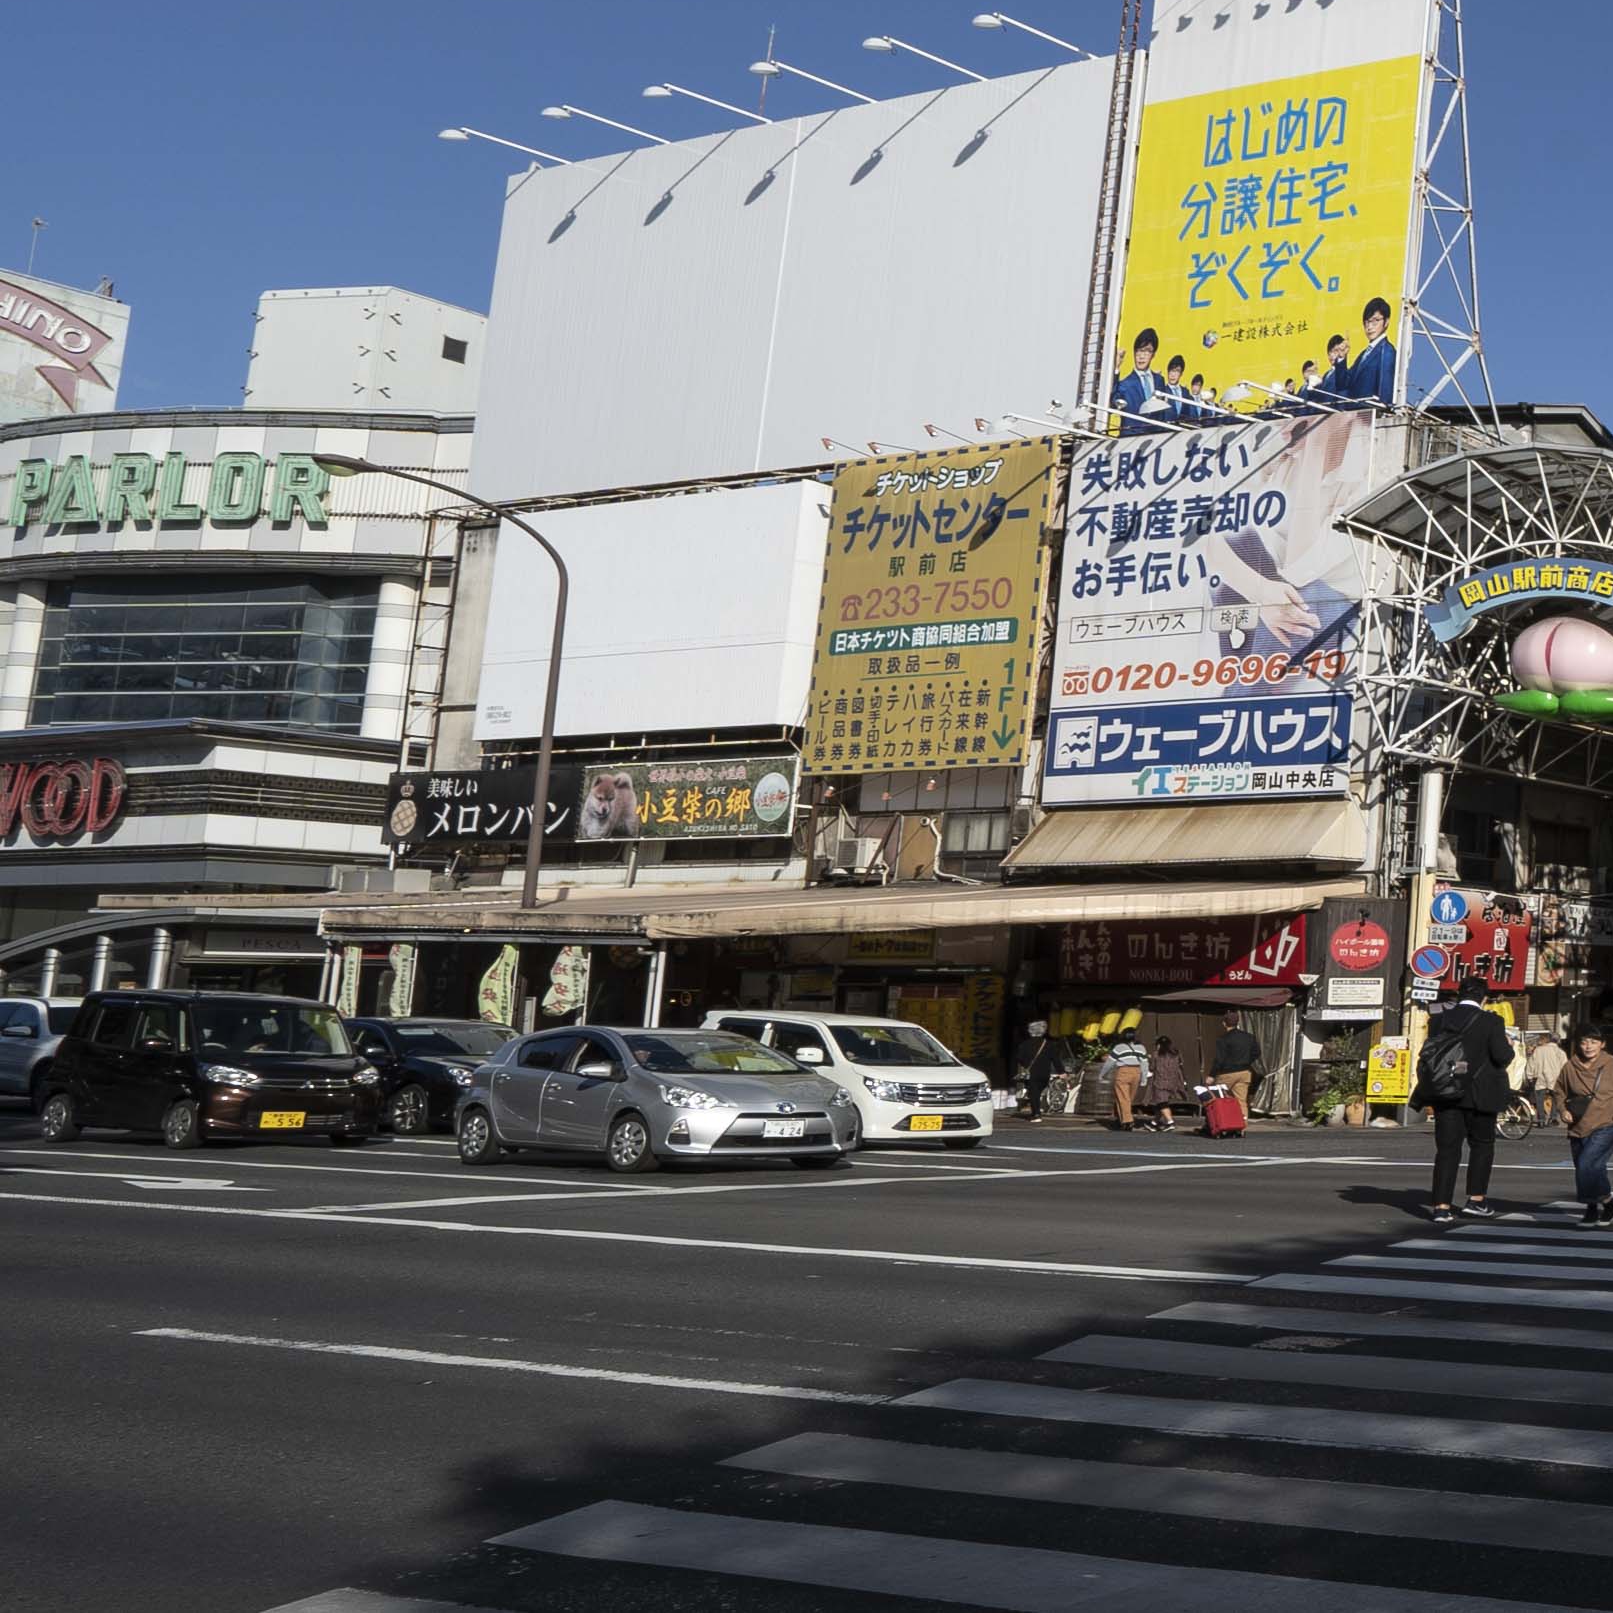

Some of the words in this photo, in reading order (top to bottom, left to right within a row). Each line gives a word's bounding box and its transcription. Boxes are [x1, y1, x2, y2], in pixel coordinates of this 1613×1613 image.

[1203, 97, 1347, 167] はじめの
[1178, 161, 1358, 241] 分譲住宅、
[1187, 234, 1339, 308] ぞくぞく。
[1221, 321, 1309, 342] 一建設株式会社
[6, 451, 331, 527] PARLOR
[876, 458, 1004, 497] チケットショップ
[1081, 443, 1249, 496] 失敗しない
[843, 491, 1030, 554] チケットセンター
[1075, 490, 1287, 547] 不動産売却の
[888, 550, 967, 577] 駅前店
[1072, 551, 1221, 600] お手伝い。
[865, 577, 1013, 620] 233-7550
[1075, 613, 1186, 638] ウェーブハウス
[868, 652, 961, 675] 取扱品一例
[1091, 649, 1346, 694] 0120-9696-19
[813, 699, 832, 762] ビール券
[830, 698, 849, 760] 商品券
[848, 697, 866, 759] 図書券
[882, 694, 900, 757] テレカ
[899, 694, 917, 757] ハイカ
[918, 692, 936, 756] 旅行券
[936, 691, 955, 755] バスカード
[953, 689, 973, 753] 在来線
[972, 688, 992, 753] 新幹線
[1099, 705, 1343, 762] ウェーブハウス
[427, 777, 478, 798] 美味しい
[636, 786, 752, 824] 小豆柴の郷
[705, 786, 727, 795] CAFE
[1252, 768, 1335, 790] 岡山中央店
[1127, 931, 1232, 961] のんき坊
[1128, 969, 1193, 982] NONKI-BOU
[1228, 969, 1253, 981] うどん
